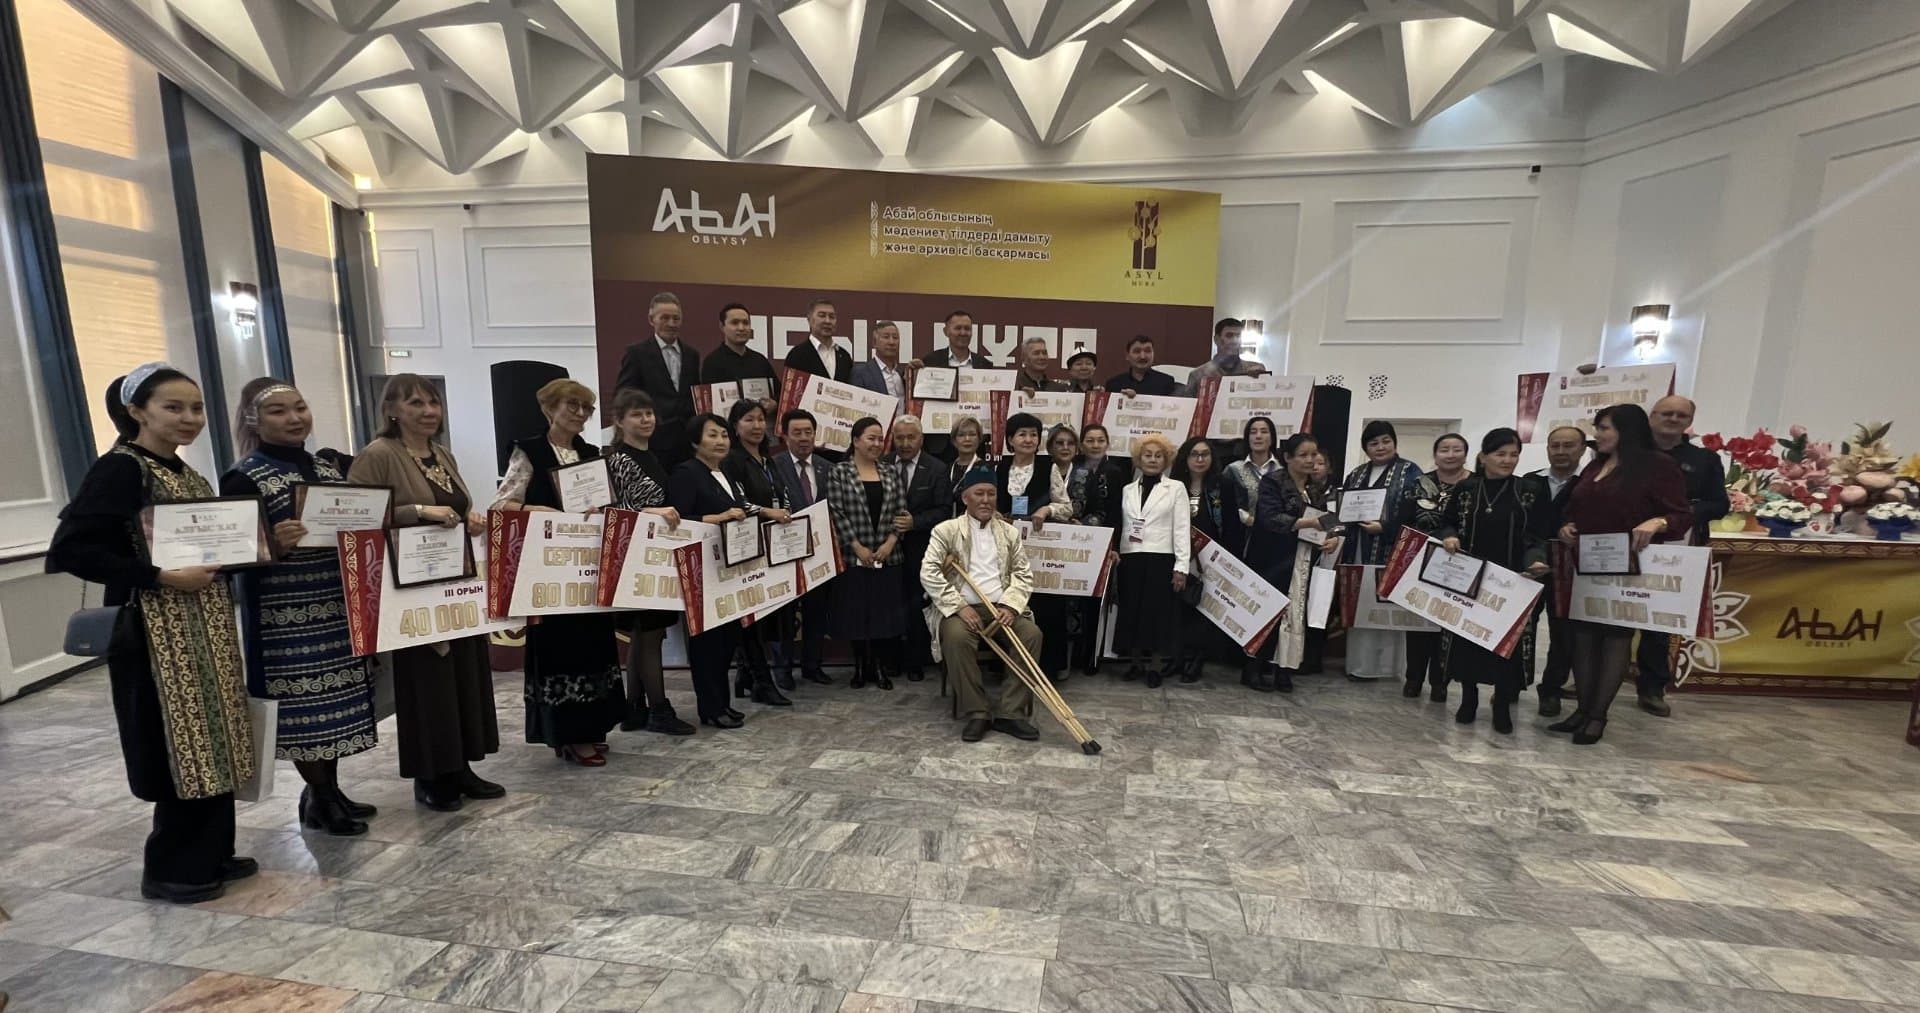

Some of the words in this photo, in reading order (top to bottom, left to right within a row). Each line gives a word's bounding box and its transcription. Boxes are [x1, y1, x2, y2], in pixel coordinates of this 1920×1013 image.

[883, 205, 916, 219] Абай
[918, 209, 993, 226] облысының
[691, 235, 747, 246] OBLYSY
[950, 227, 1002, 246] тілдерді
[1003, 231, 1050, 247] дамыту
[884, 242, 916, 253] және
[918, 244, 955, 258] архив
[958, 244, 973, 256] ісі
[975, 245, 1050, 260] басқармасы
[1124, 270, 1164, 281] ASYL
[643, 546, 677, 567] СЕРТ
[633, 573, 656, 597] 30
[747, 571, 766, 582] ОРЫН
[444, 589, 454, 598] III
[457, 585, 484, 596] ОРЫН
[532, 582, 561, 608] 80
[715, 593, 737, 619] 60
[736, 583, 766, 611] 000
[1626, 590, 1650, 598] ОРЫН
[400, 606, 432, 638] 40
[434, 600, 479, 633] 000
